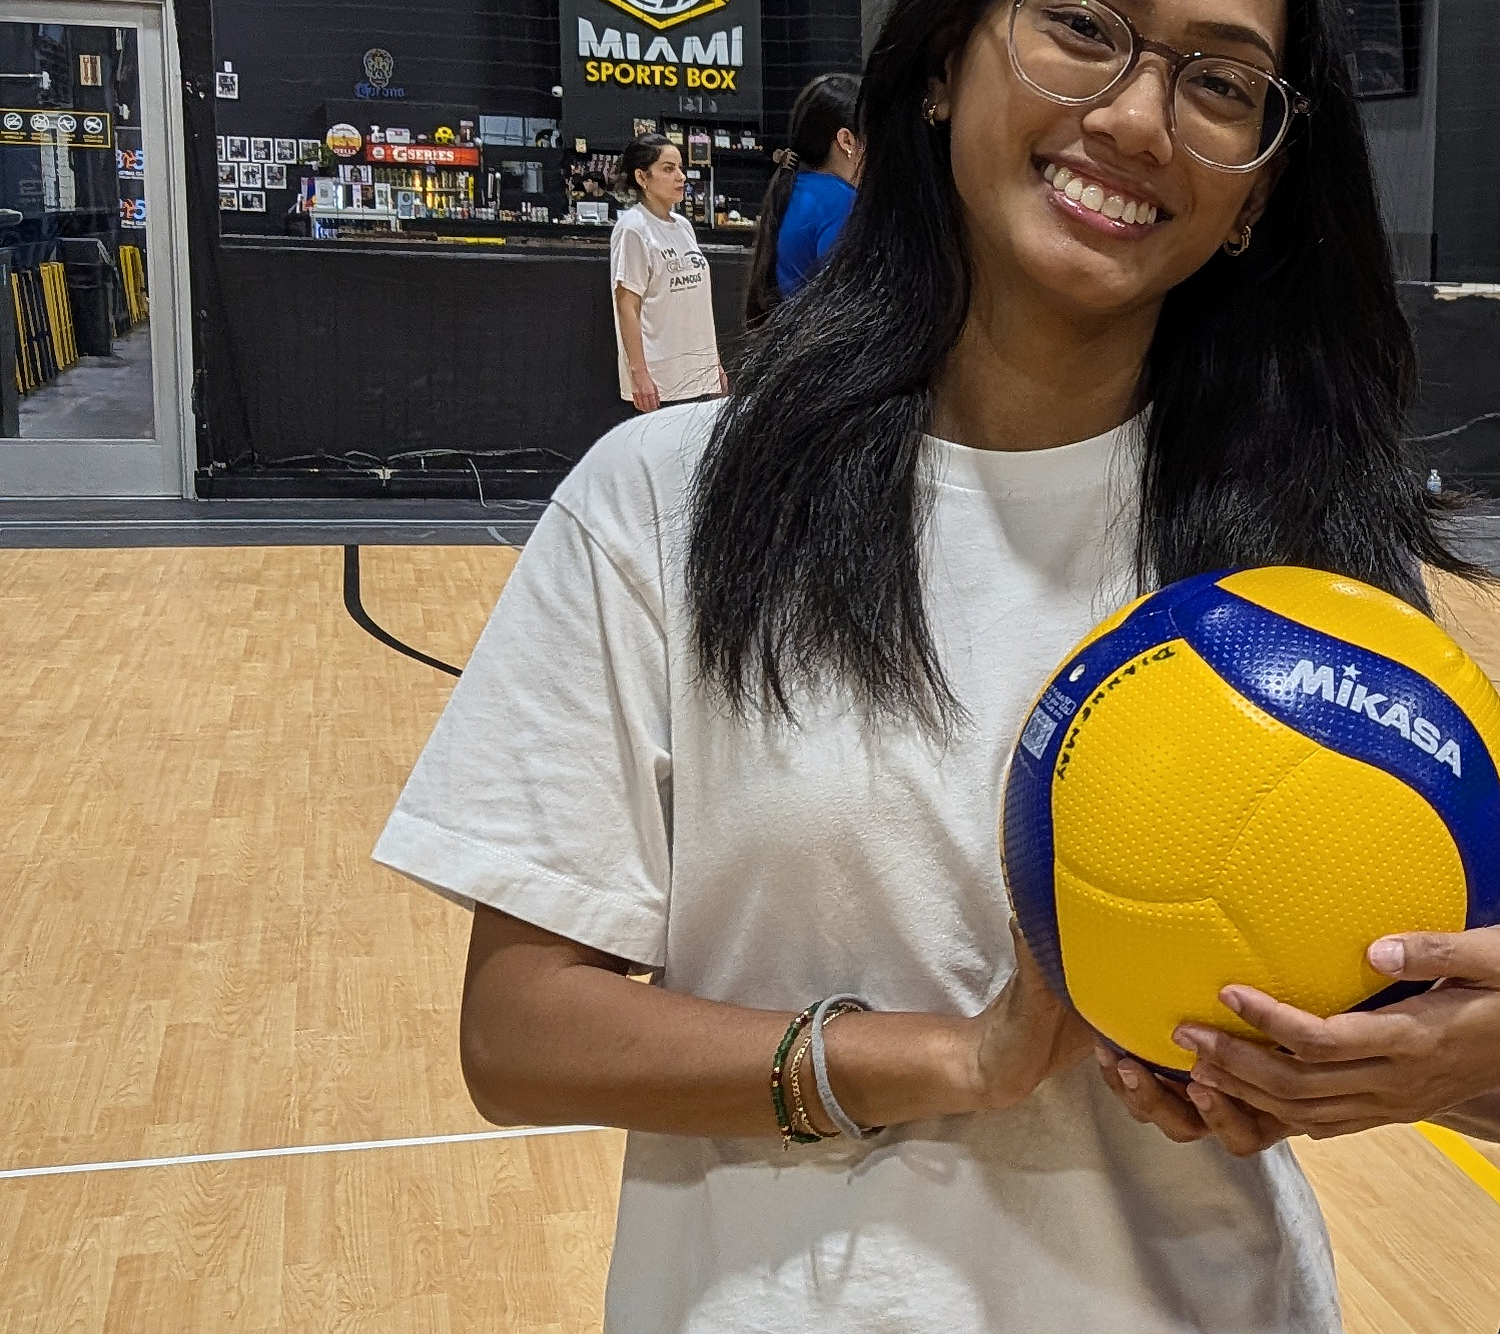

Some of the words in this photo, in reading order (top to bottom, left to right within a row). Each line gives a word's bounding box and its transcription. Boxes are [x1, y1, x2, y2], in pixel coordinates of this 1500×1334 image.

[578, 17, 743, 66] MIAMI
[586, 61, 678, 87] SPORTS
[687, 69, 736, 91] BOX
[661, 247, 678, 260] I'M
[670, 273, 702, 288] FAMOUS
